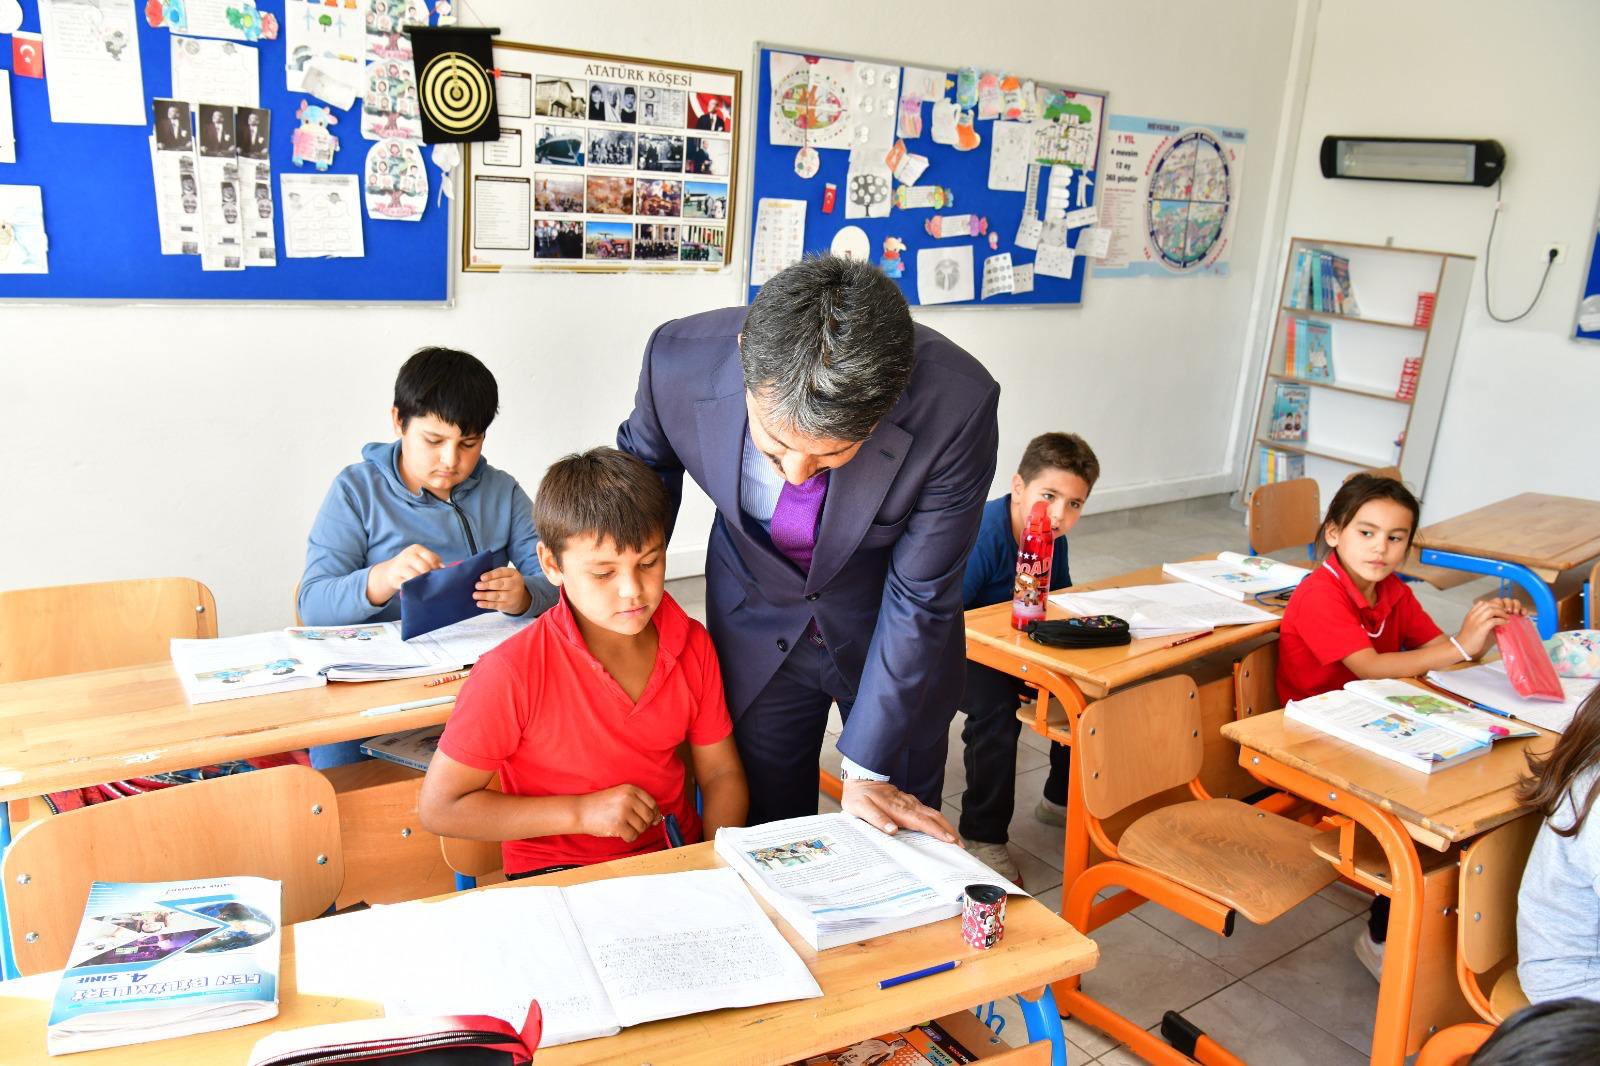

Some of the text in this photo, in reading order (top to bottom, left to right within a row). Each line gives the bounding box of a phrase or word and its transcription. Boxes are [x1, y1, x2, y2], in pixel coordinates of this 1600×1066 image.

[584, 63, 693, 87] ATATÜRK KÖŞESİ
[78, 974, 118, 984] SINIF
[215, 973, 262, 986] FEN
